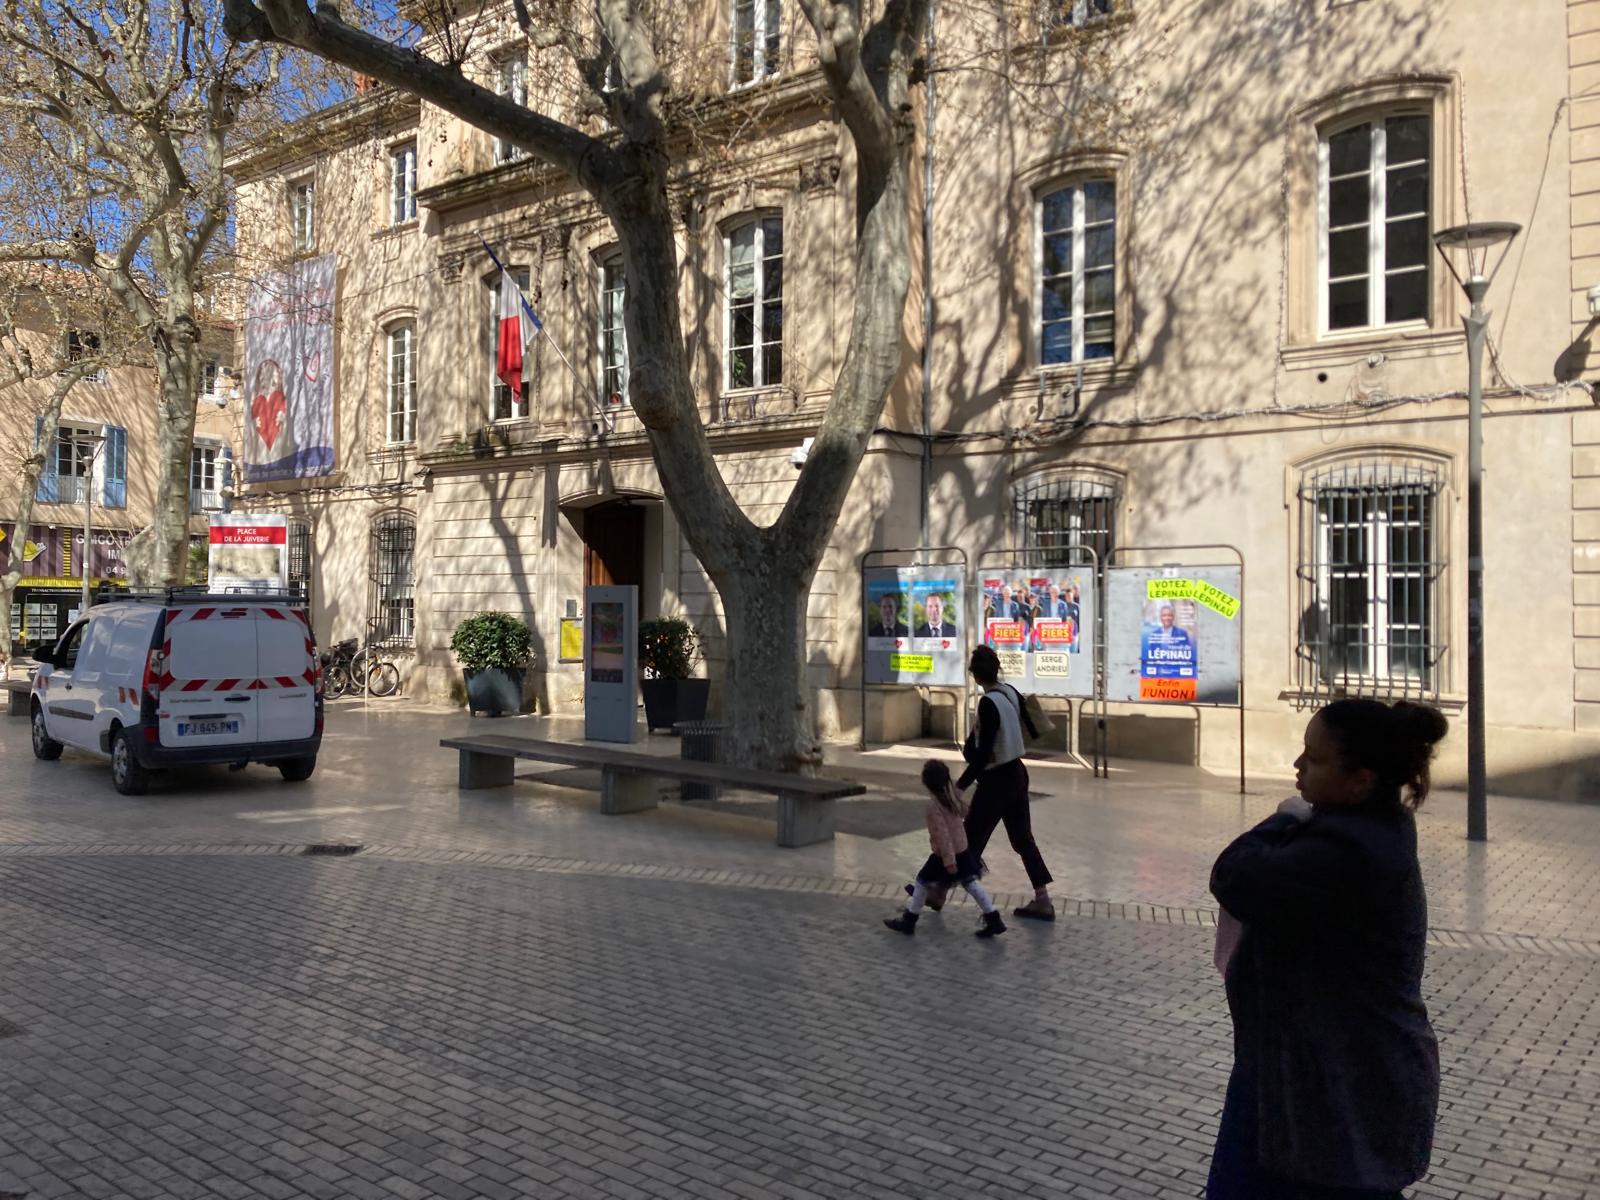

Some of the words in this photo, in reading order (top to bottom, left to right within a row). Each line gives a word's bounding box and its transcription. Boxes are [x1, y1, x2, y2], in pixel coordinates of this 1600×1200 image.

[75, 533, 115, 546] GMCO
[243, 535, 270, 543] JUIVERIE
[1154, 580, 1187, 588] VOTEZ
[1149, 589, 1193, 598] LEPINAU
[1203, 583, 1234, 606] VOTEZ
[1193, 590, 1234, 617] LEPINAU
[994, 629, 1020, 637] FIERS
[1041, 629, 1069, 637] FIERS
[1148, 647, 1192, 660] LÉPINAU
[1041, 655, 1063, 663] SERGE
[1037, 665, 1068, 673] ANDRIEU
[1157, 679, 1180, 687] Enfin
